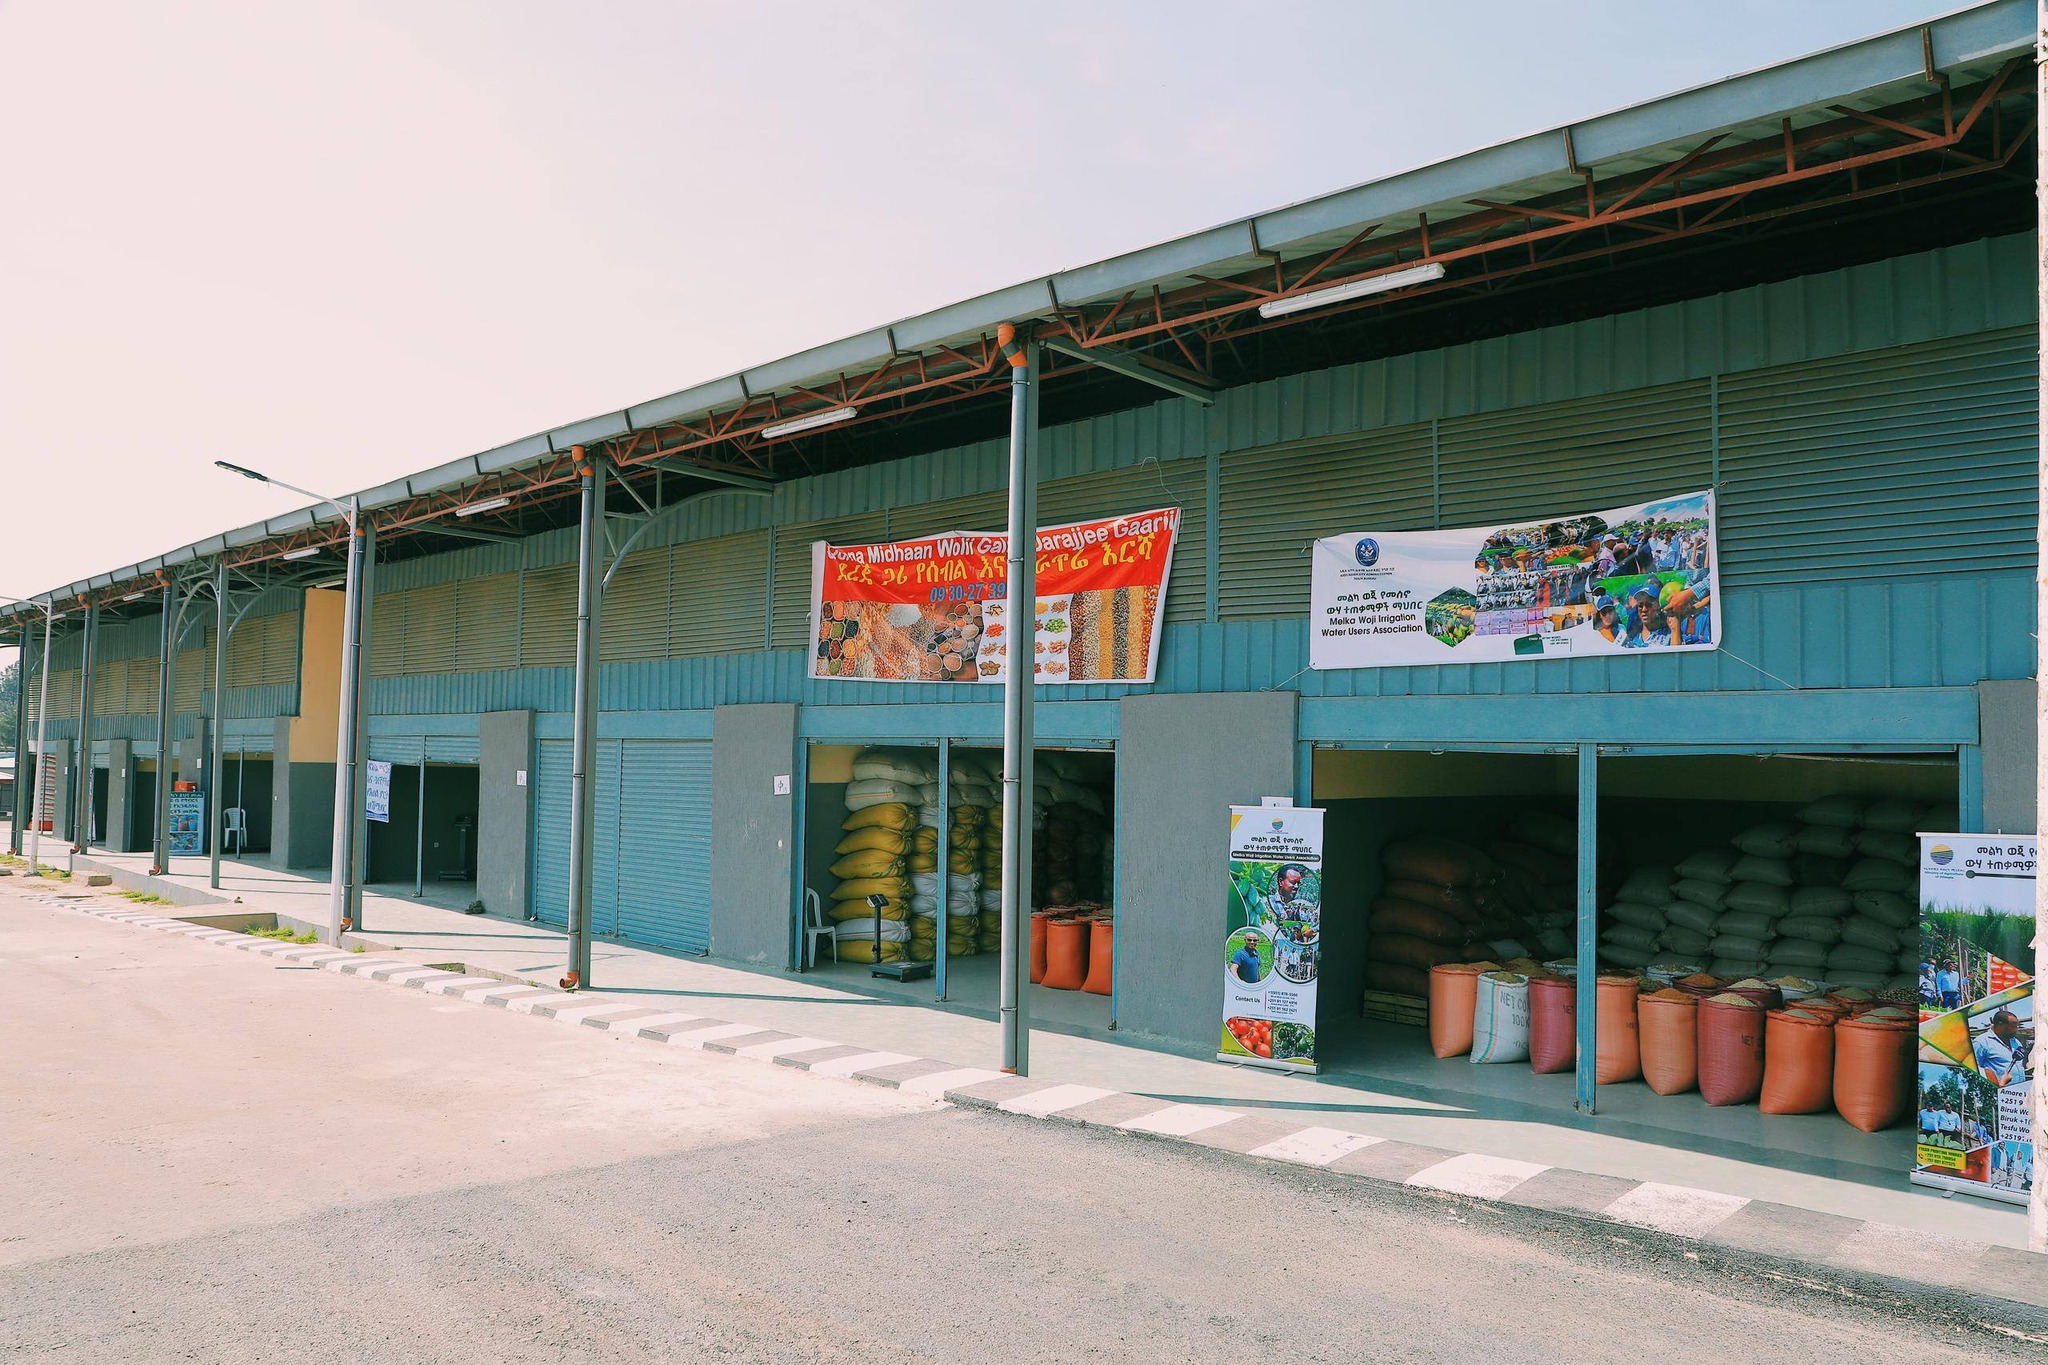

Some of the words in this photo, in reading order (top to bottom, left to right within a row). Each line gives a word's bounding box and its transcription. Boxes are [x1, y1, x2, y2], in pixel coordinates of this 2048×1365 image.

[867, 543, 933, 564] Midhaan
[937, 537, 975, 557] Wolii
[977, 537, 1008, 555] Gal
[1113, 510, 1176, 539] Gaarii
[916, 560, 967, 583] የሰብል
[1036, 548, 1089, 575] ራፍሬ
[930, 586, 945, 602] 09
[1337, 594, 1359, 602] መልካ
[1329, 616, 1356, 626] Melka
[1358, 615, 1377, 625] Woji
[1378, 613, 1417, 625] Irrigation
[1321, 628, 1347, 637] Water
[1348, 627, 1371, 636] Users
[1372, 624, 1424, 635] Association
[1977, 846, 2003, 856] መልካ
[1235, 995, 1254, 1003] Contact
[1500, 991, 1515, 1009] NET
[2000, 1088, 2023, 1098] Amare
[2000, 1105, 2018, 1114] Biruk
[2000, 1114, 2018, 1123] Biruk
[2000, 1123, 2018, 1132] Tesfu
